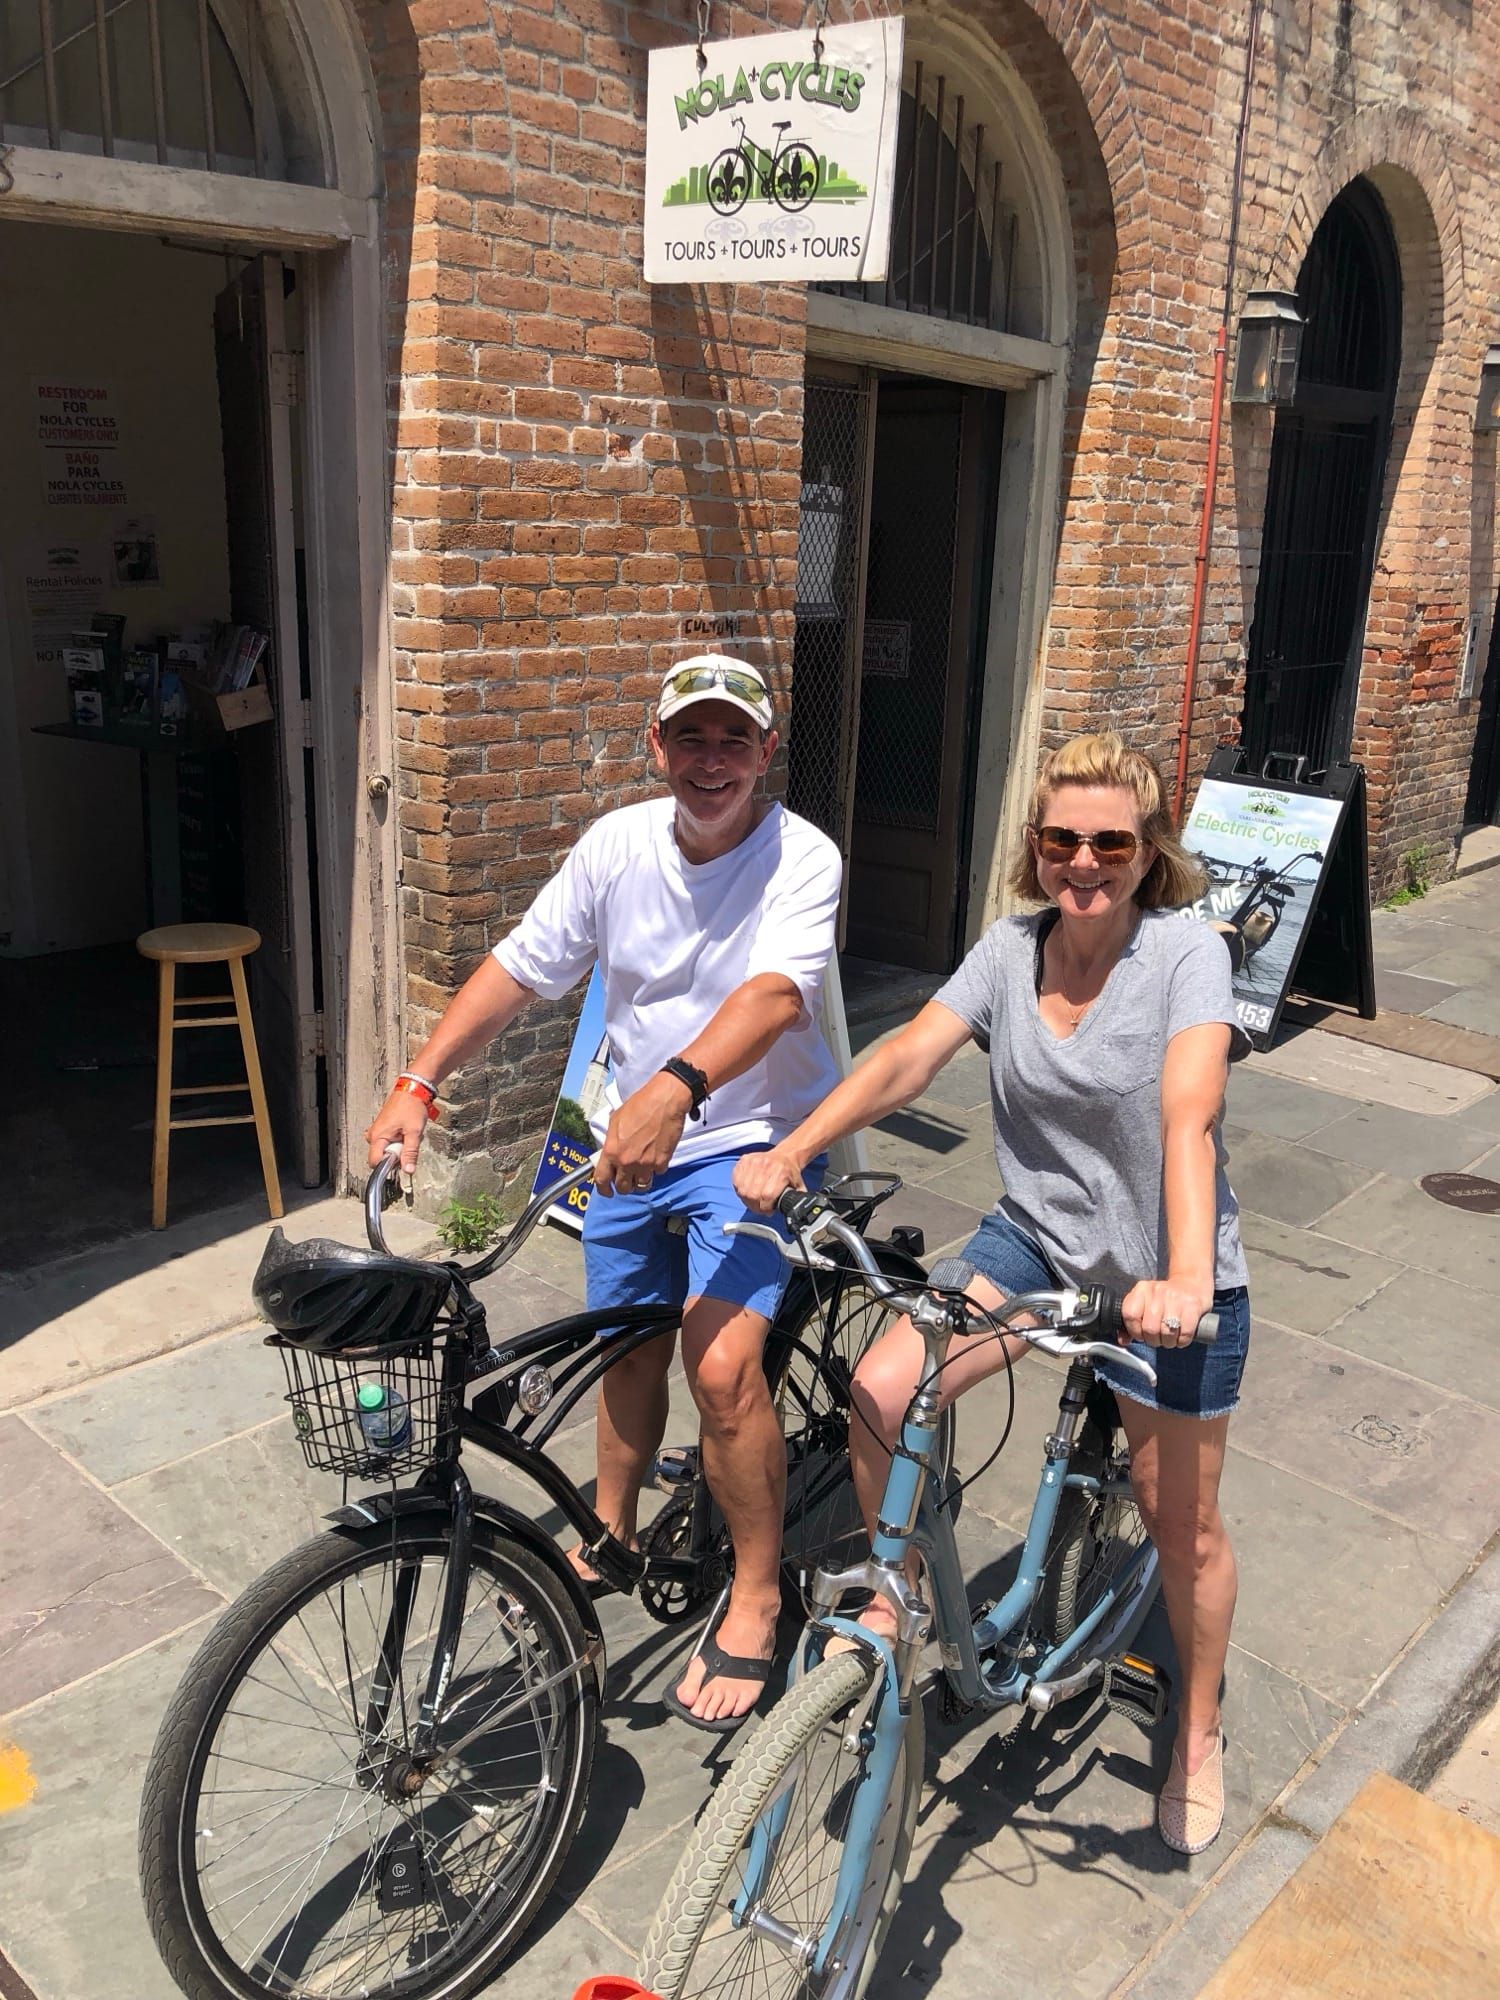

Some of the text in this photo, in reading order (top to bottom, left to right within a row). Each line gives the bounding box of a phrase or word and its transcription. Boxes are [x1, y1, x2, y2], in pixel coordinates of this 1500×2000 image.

[674, 61, 866, 131] NOLA CYCLES
[665, 236, 861, 261] TOURS TOURS TOURS
[38, 386, 107, 400] RESTROOM
[63, 402, 88, 413] FOR
[40, 415, 116, 427] NOLA CYCLES
[38, 428, 120, 442] CUSTOMERS ONLY
[65, 450, 99, 464] BAÑO
[68, 467, 100, 478] PARA
[48, 481, 124, 491] NOLA CYCLES
[26, 575, 103, 588] Rental Policies
[36, 650, 54, 662] NO
[1194, 812, 1257, 838] Electric
[1263, 826, 1320, 850] Cycles
[1210, 881, 1244, 916] ME
[562, 1146, 568, 1156] 3
